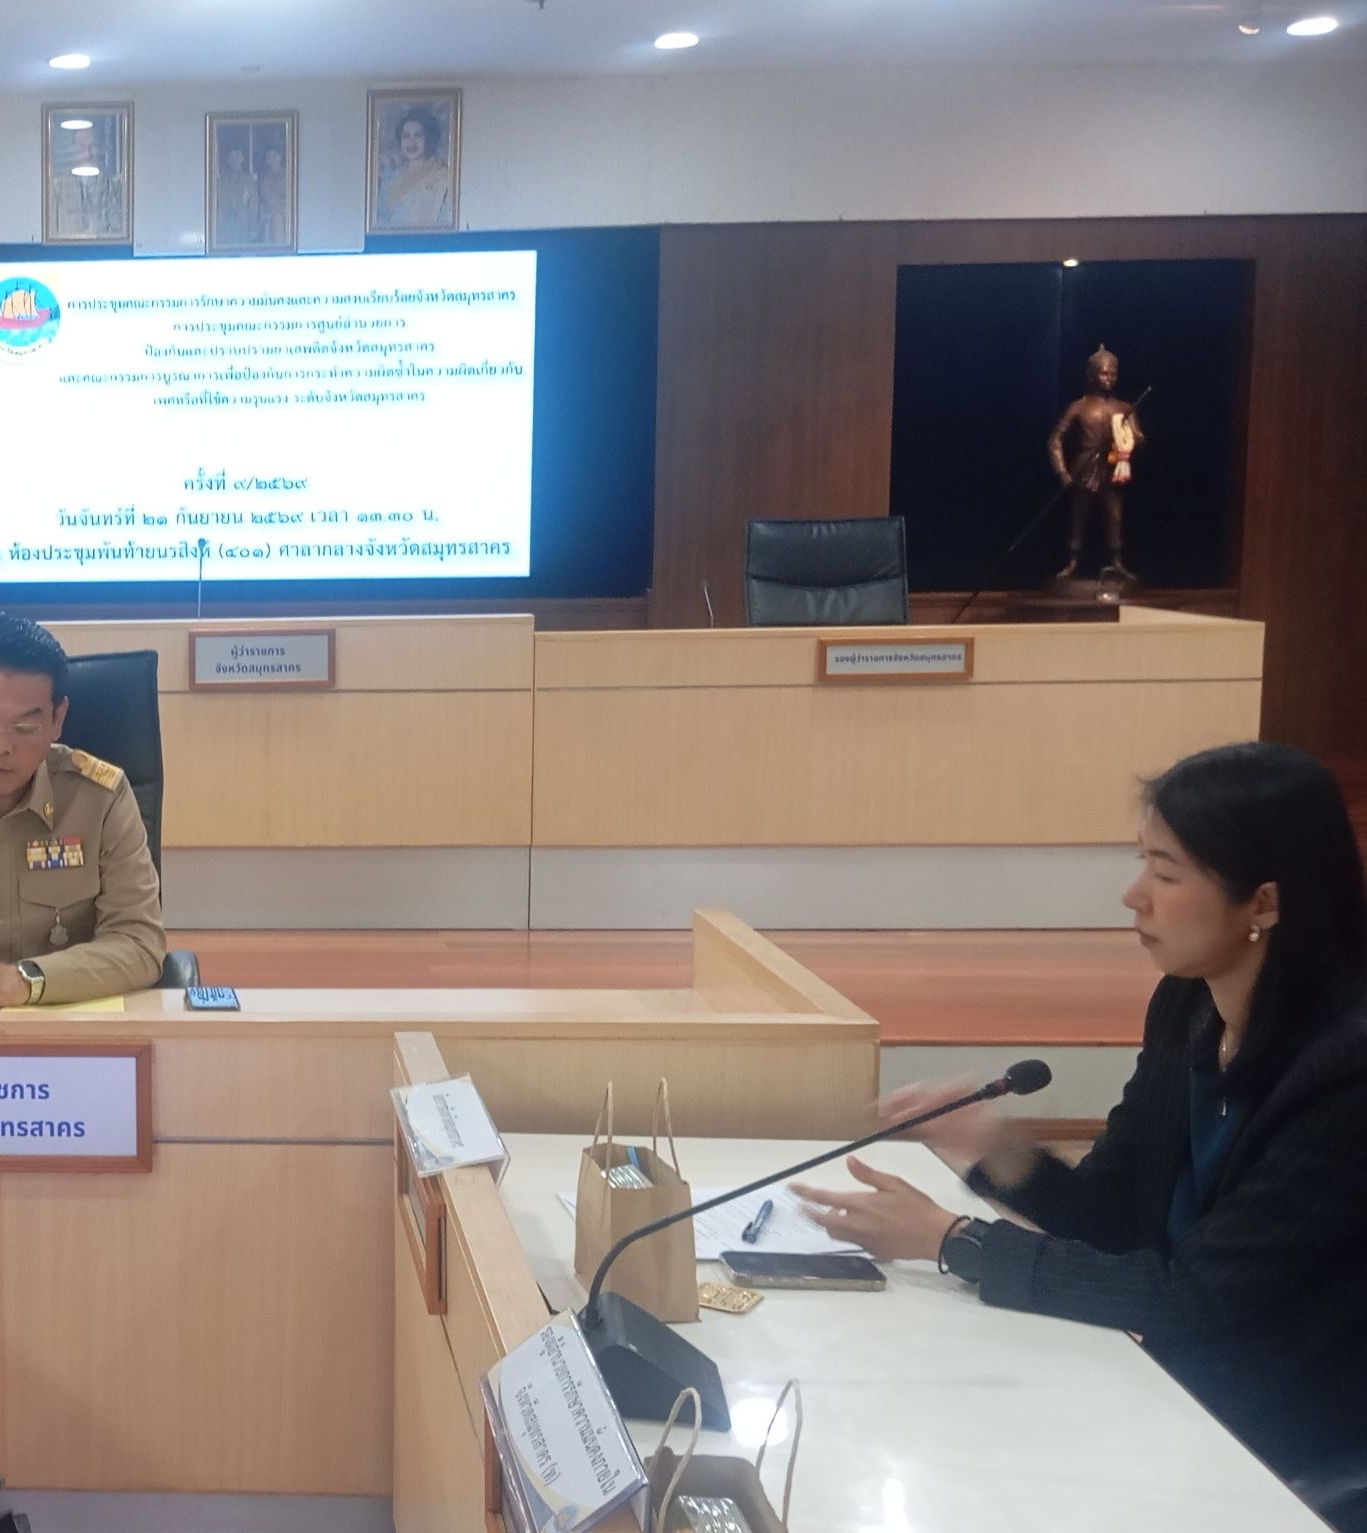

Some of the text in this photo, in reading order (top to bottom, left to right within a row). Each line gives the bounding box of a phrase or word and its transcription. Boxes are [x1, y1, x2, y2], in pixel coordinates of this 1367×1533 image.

[184, 466, 226, 490] ครั้งที่
[58, 504, 135, 526] วันจันทร์ที่
[143, 512, 168, 525] ๒๑
[176, 506, 243, 525] กันยายน
[251, 511, 303, 524] ๒๕๖๙
[311, 510, 348, 523] เวลา
[422, 508, 439, 523] น.
[279, 537, 510, 561] ศาลากลางจังหวัดสมุทรสาคร
[540, 1326, 621, 1496] รองผู้อำนวยการรักษาความมั่นคงภายใน
[515, 1383, 552, 1469] จังหวัดสมุทรสาคร
